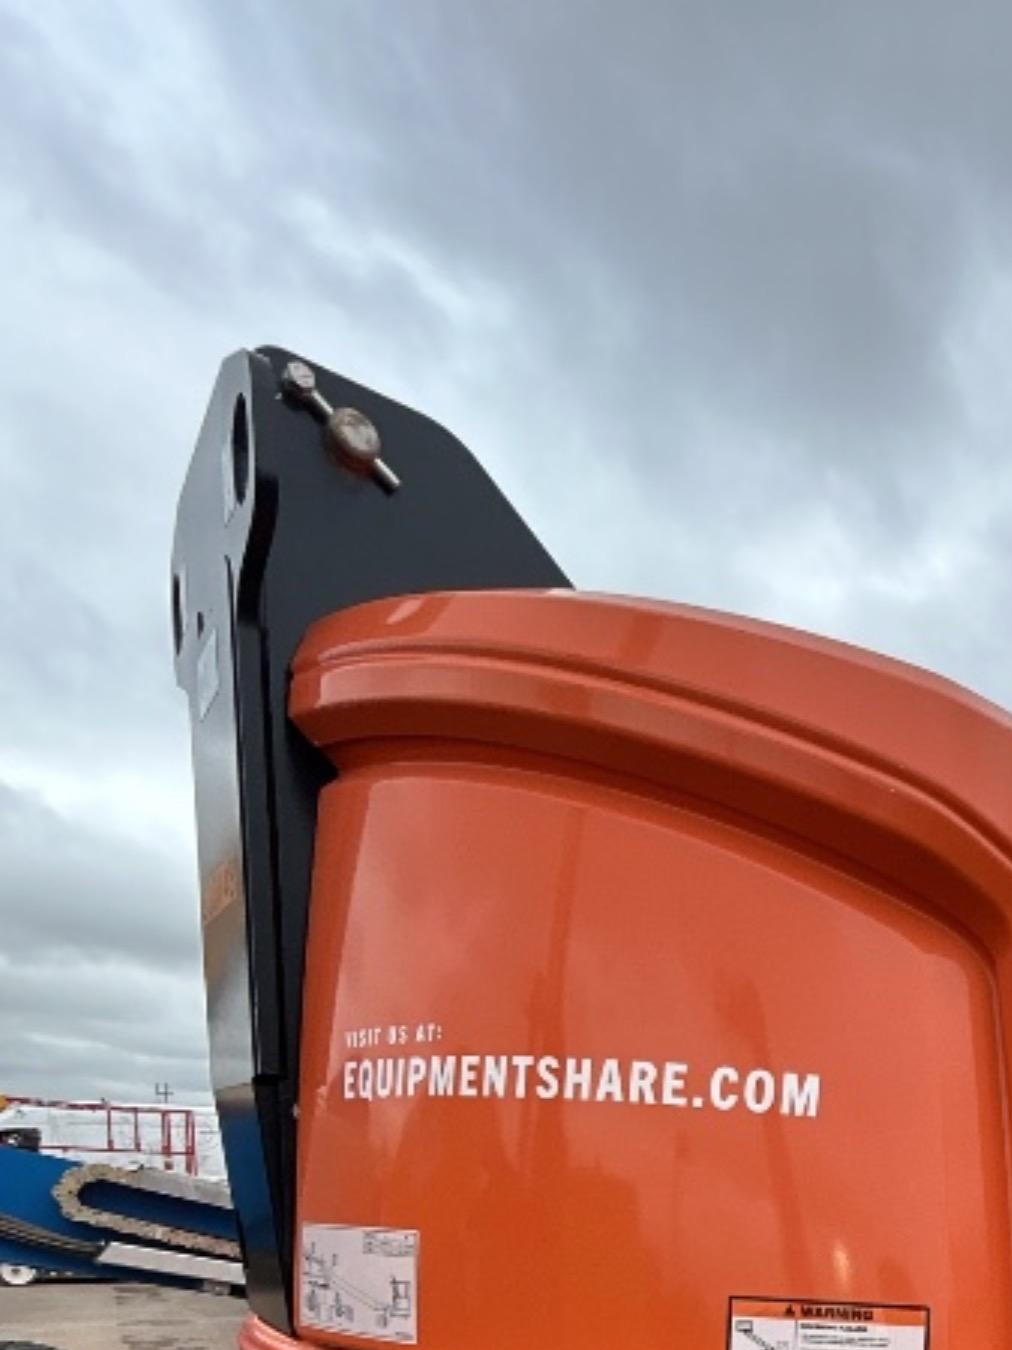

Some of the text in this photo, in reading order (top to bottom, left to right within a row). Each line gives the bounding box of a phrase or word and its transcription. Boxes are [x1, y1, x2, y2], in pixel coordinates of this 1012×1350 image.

[345, 1023, 443, 1048] VISIT US AT:
[344, 1055, 821, 1118] EQUIPMENTSHARE.COM
[801, 1305, 874, 1321] WARNING
